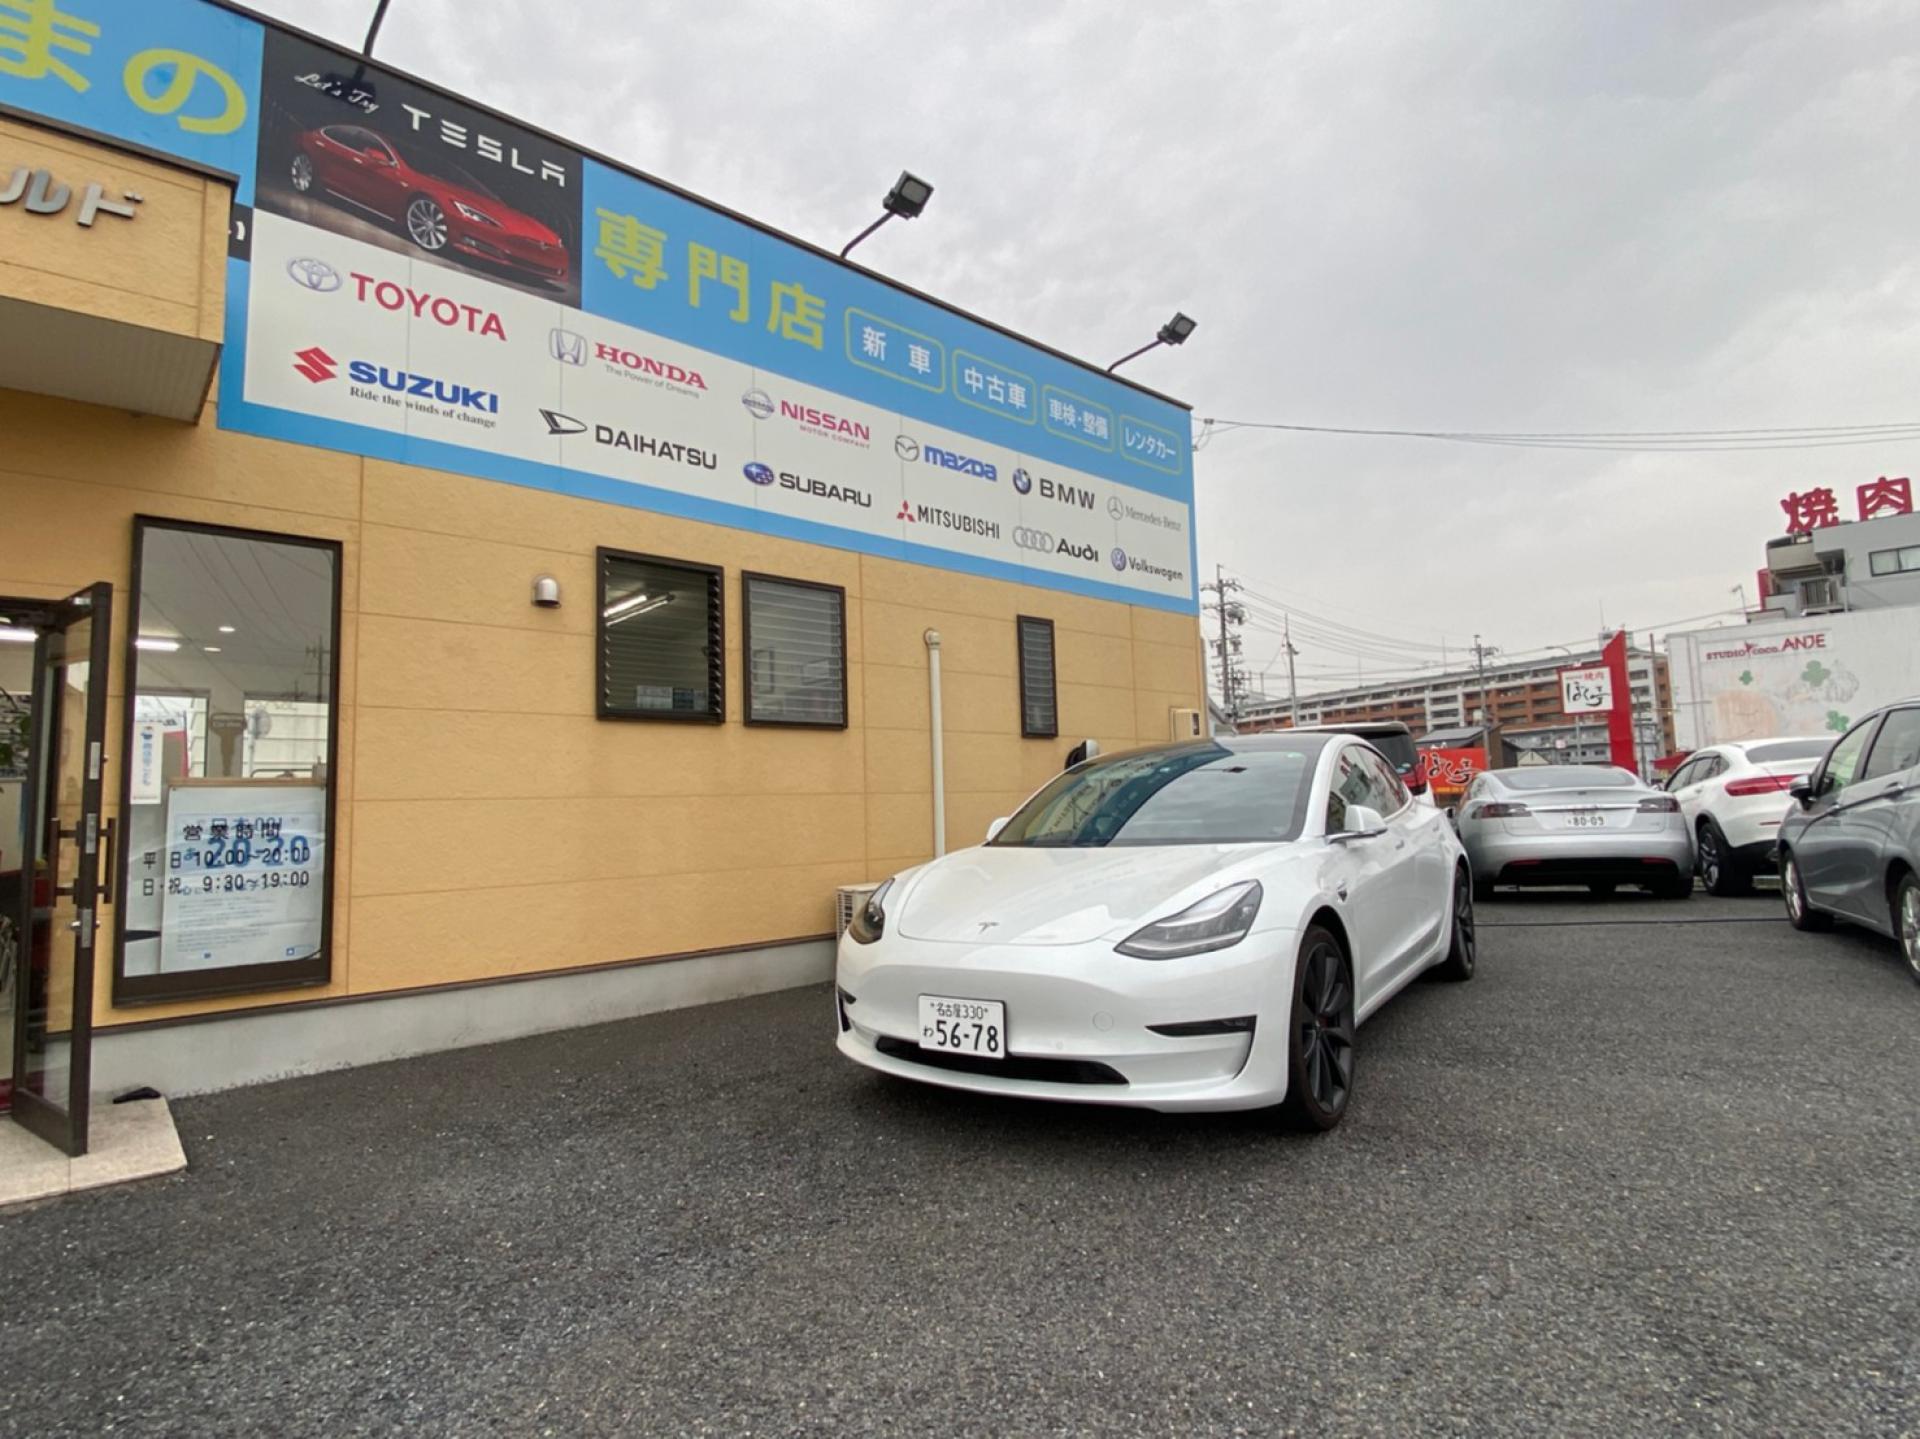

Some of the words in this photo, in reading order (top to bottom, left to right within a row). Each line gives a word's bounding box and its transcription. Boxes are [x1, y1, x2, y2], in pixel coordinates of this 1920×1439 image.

[293, 73, 343, 98] Let's
[347, 87, 380, 115] Try
[401, 103, 566, 188] TESLA
[594, 206, 827, 352] 専門店
[350, 271, 508, 342] TOYOTA
[594, 342, 709, 391] HONDA
[604, 363, 623, 377] The
[624, 367, 653, 385] Power
[653, 379, 665, 388] of
[665, 382, 701, 400] Dreams
[348, 360, 499, 414] SUZUKI
[963, 366, 1028, 410] 中古車
[350, 386, 379, 403] Ride
[381, 394, 402, 408] the
[405, 397, 440, 417] winds
[442, 407, 455, 419] of
[456, 409, 497, 429] change
[781, 399, 870, 441] NISSAN
[595, 423, 718, 471] DAIHATSU
[799, 424, 829, 437] MOTOR
[831, 433, 871, 450] COMPANY
[1124, 426, 1177, 460] レンタカー
[779, 471, 872, 508] SUBARU
[1039, 478, 1096, 511] BMW
[1780, 475, 1914, 535] 焼肉
[917, 503, 1000, 540] MITSUBISHI
[1125, 504, 1182, 532] Mercedes-Benz
[1055, 538, 1100, 563] Audi
[1128, 556, 1184, 582] Volkswagen
[1706, 649, 1746, 660] STUDIO
[923, 1025, 934, 1038] わ
[936, 1019, 999, 1053] 56-78
